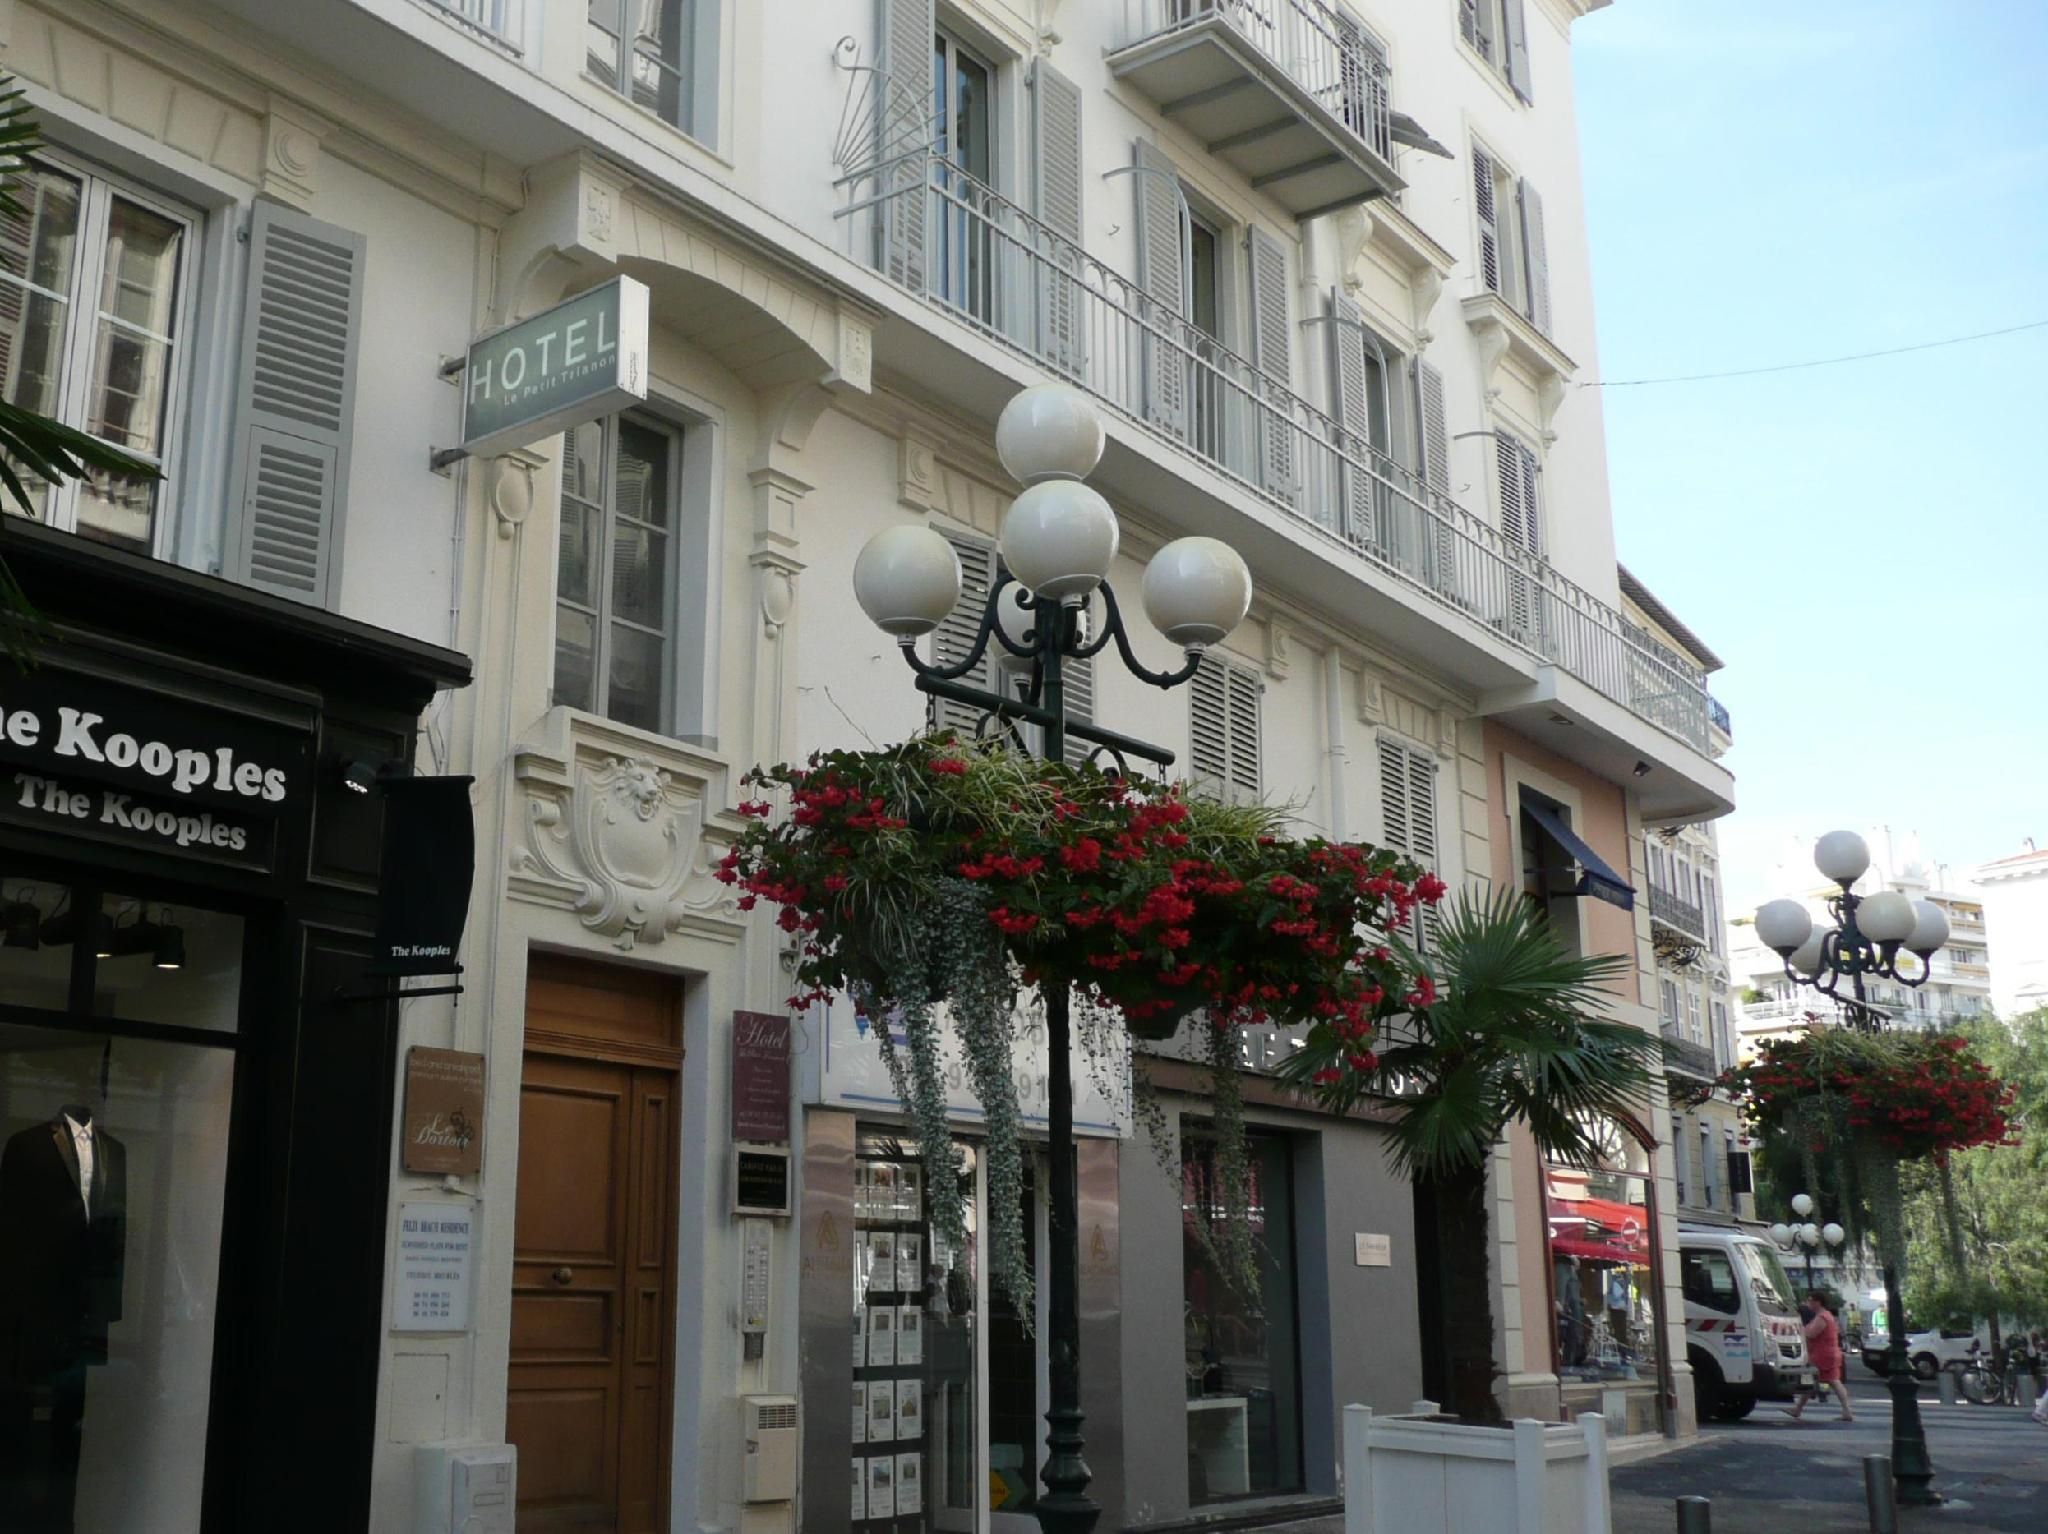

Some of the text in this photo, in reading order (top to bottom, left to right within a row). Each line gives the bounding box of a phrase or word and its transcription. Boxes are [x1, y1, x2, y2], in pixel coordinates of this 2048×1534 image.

[470, 311, 616, 405] HOTEL
[504, 392, 518, 406] Le
[561, 354, 616, 384] Trianon
[54, 706, 287, 802] Kooples
[15, 772, 248, 851] The Kooples
[391, 945, 451, 957] The Kooples
